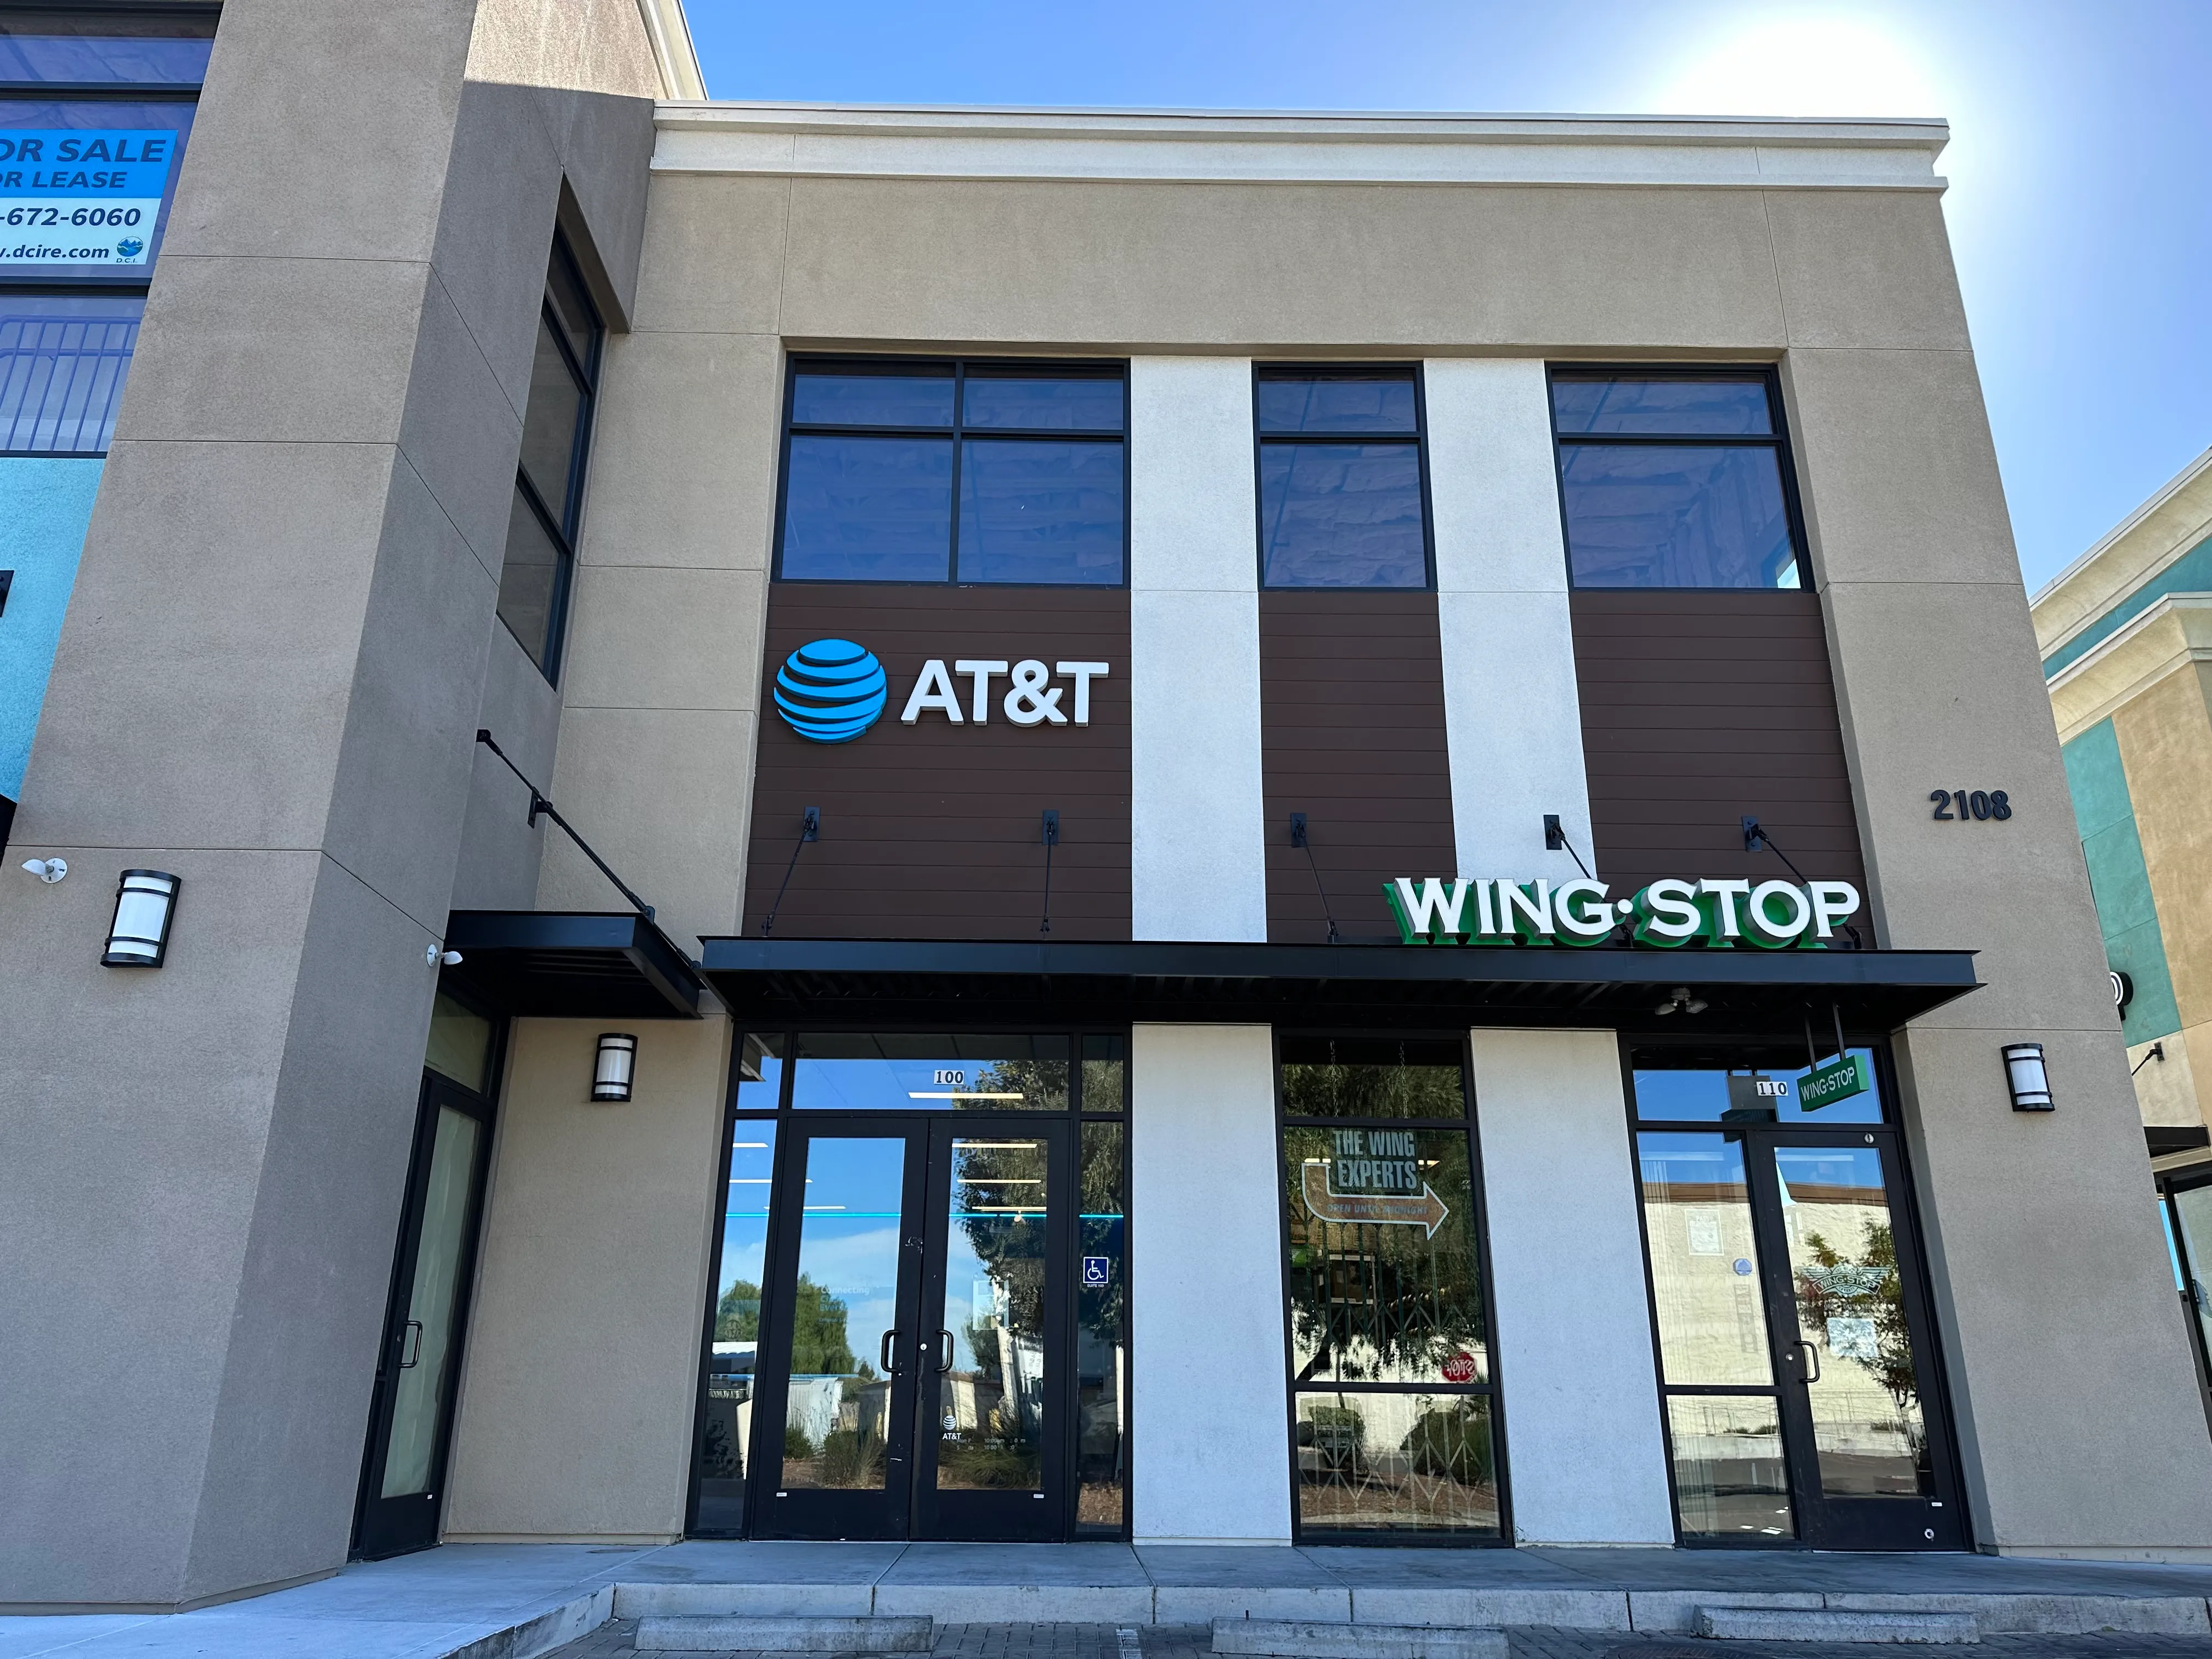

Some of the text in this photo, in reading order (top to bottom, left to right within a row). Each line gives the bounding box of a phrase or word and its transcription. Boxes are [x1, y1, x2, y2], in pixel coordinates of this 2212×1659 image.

[56, 139, 166, 162] SALE
[0, 171, 127, 188] R LEASE
[901, 659, 1109, 727] AT&T
[1930, 789, 2012, 820] 2108
[936, 1071, 963, 1084] 100
[1759, 1082, 1787, 1095] 110
[1333, 1130, 1415, 1157] THE WING
[1337, 1159, 1417, 1189] EXPERTS
[1327, 1204, 1351, 1213] OPEN
[821, 1286, 870, 1296] Connecting
